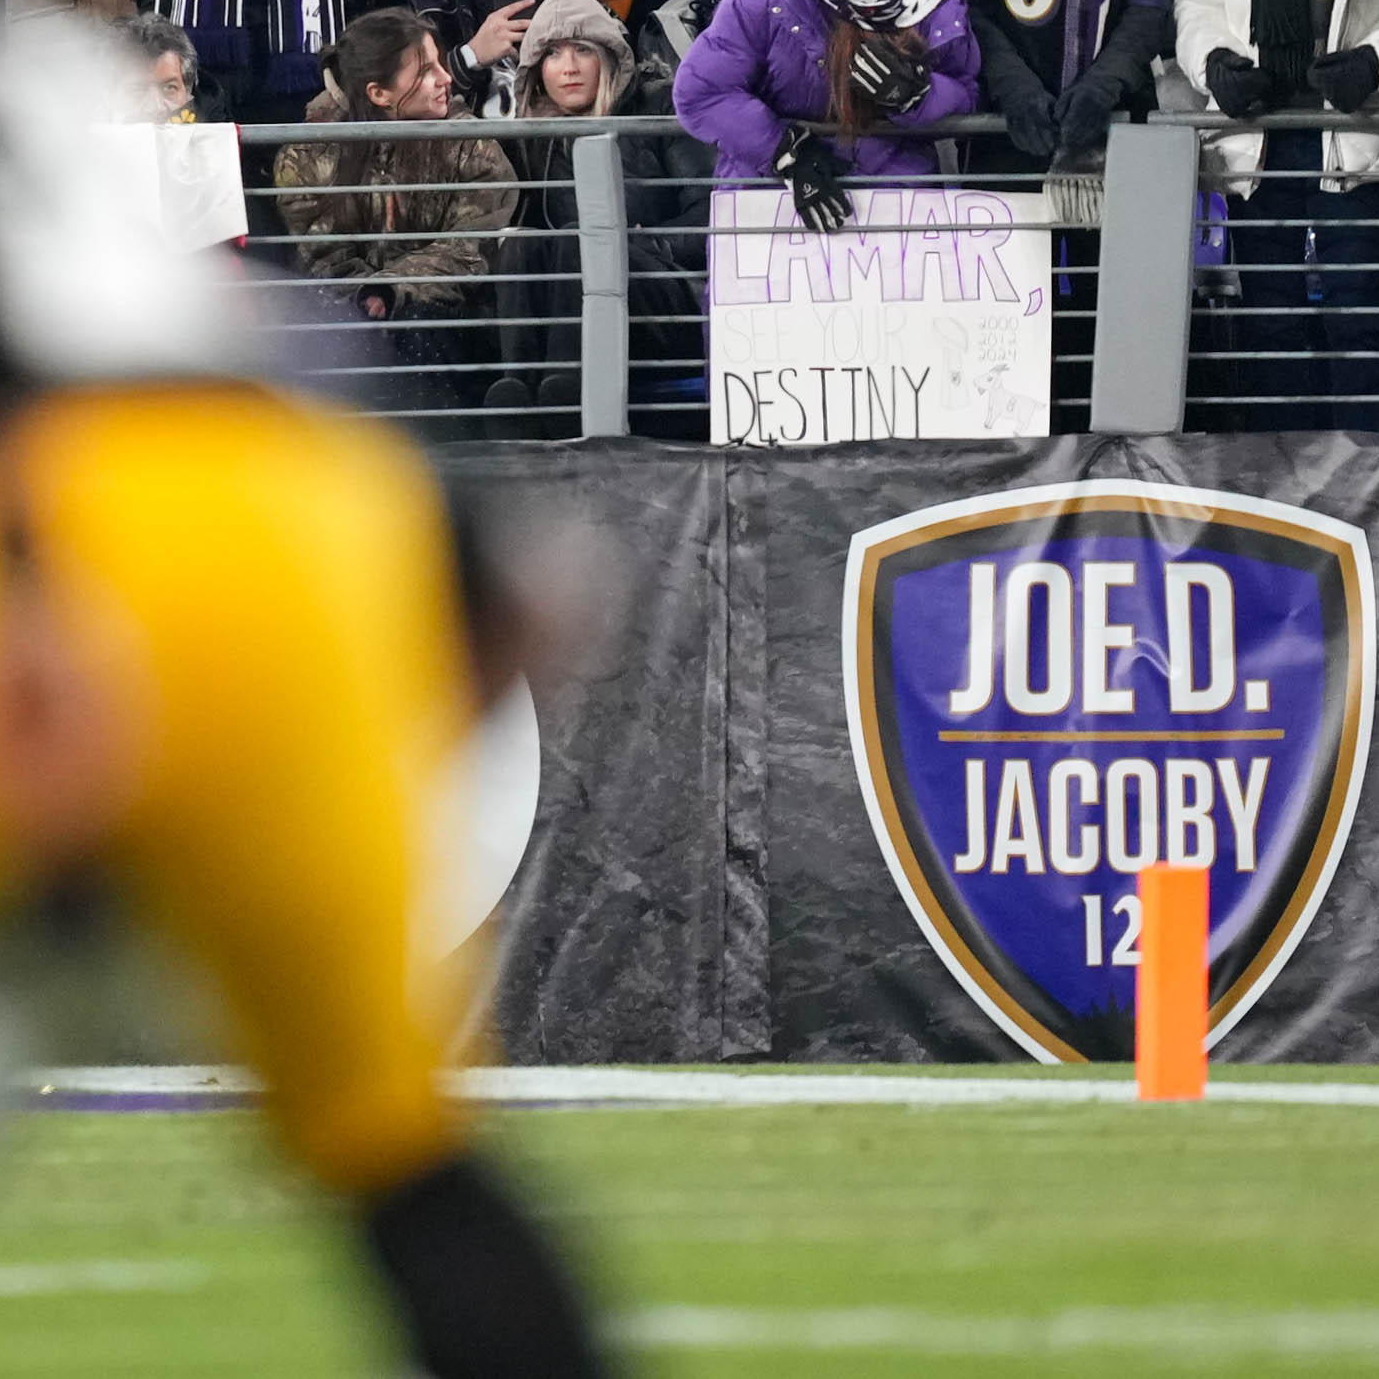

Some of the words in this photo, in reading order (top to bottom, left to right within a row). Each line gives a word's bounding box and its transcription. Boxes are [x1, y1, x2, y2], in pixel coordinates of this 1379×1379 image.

[723, 364, 931, 445] DESTINY
[949, 561, 1135, 717] JOE
[1164, 561, 1270, 714] D.
[954, 756, 1272, 875] JACOBY
